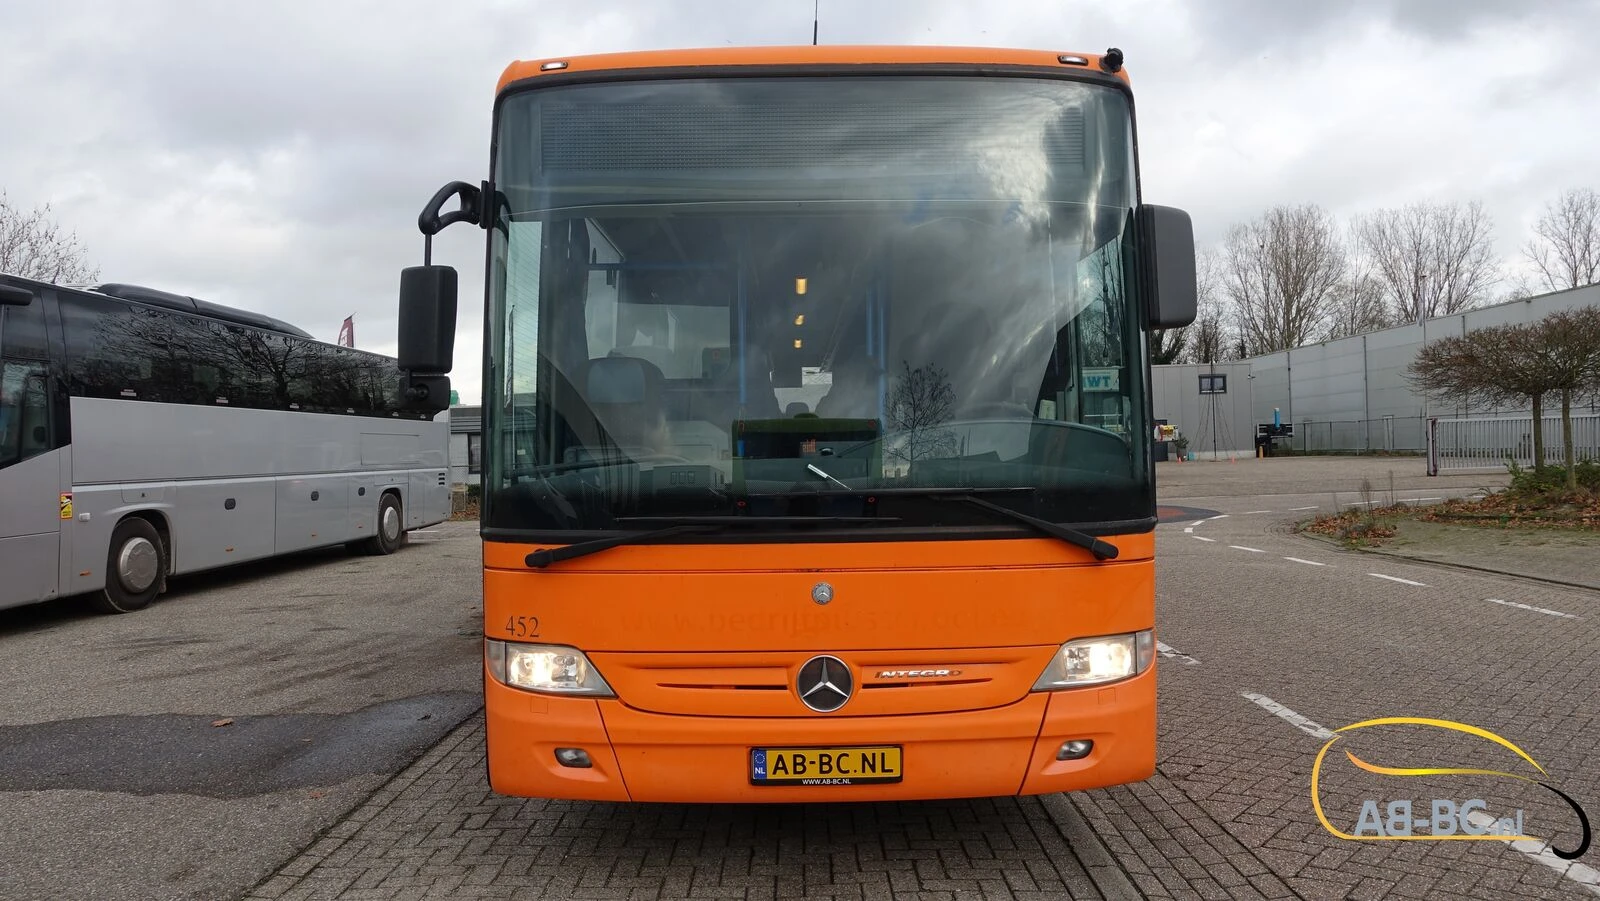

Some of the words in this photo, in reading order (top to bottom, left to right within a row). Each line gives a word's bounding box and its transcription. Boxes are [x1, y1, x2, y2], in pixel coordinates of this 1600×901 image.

[505, 615, 540, 638] 452
[874, 669, 962, 679] INTEGRO
[754, 766, 766, 775] NL
[772, 752, 894, 776] AB-BC.NL
